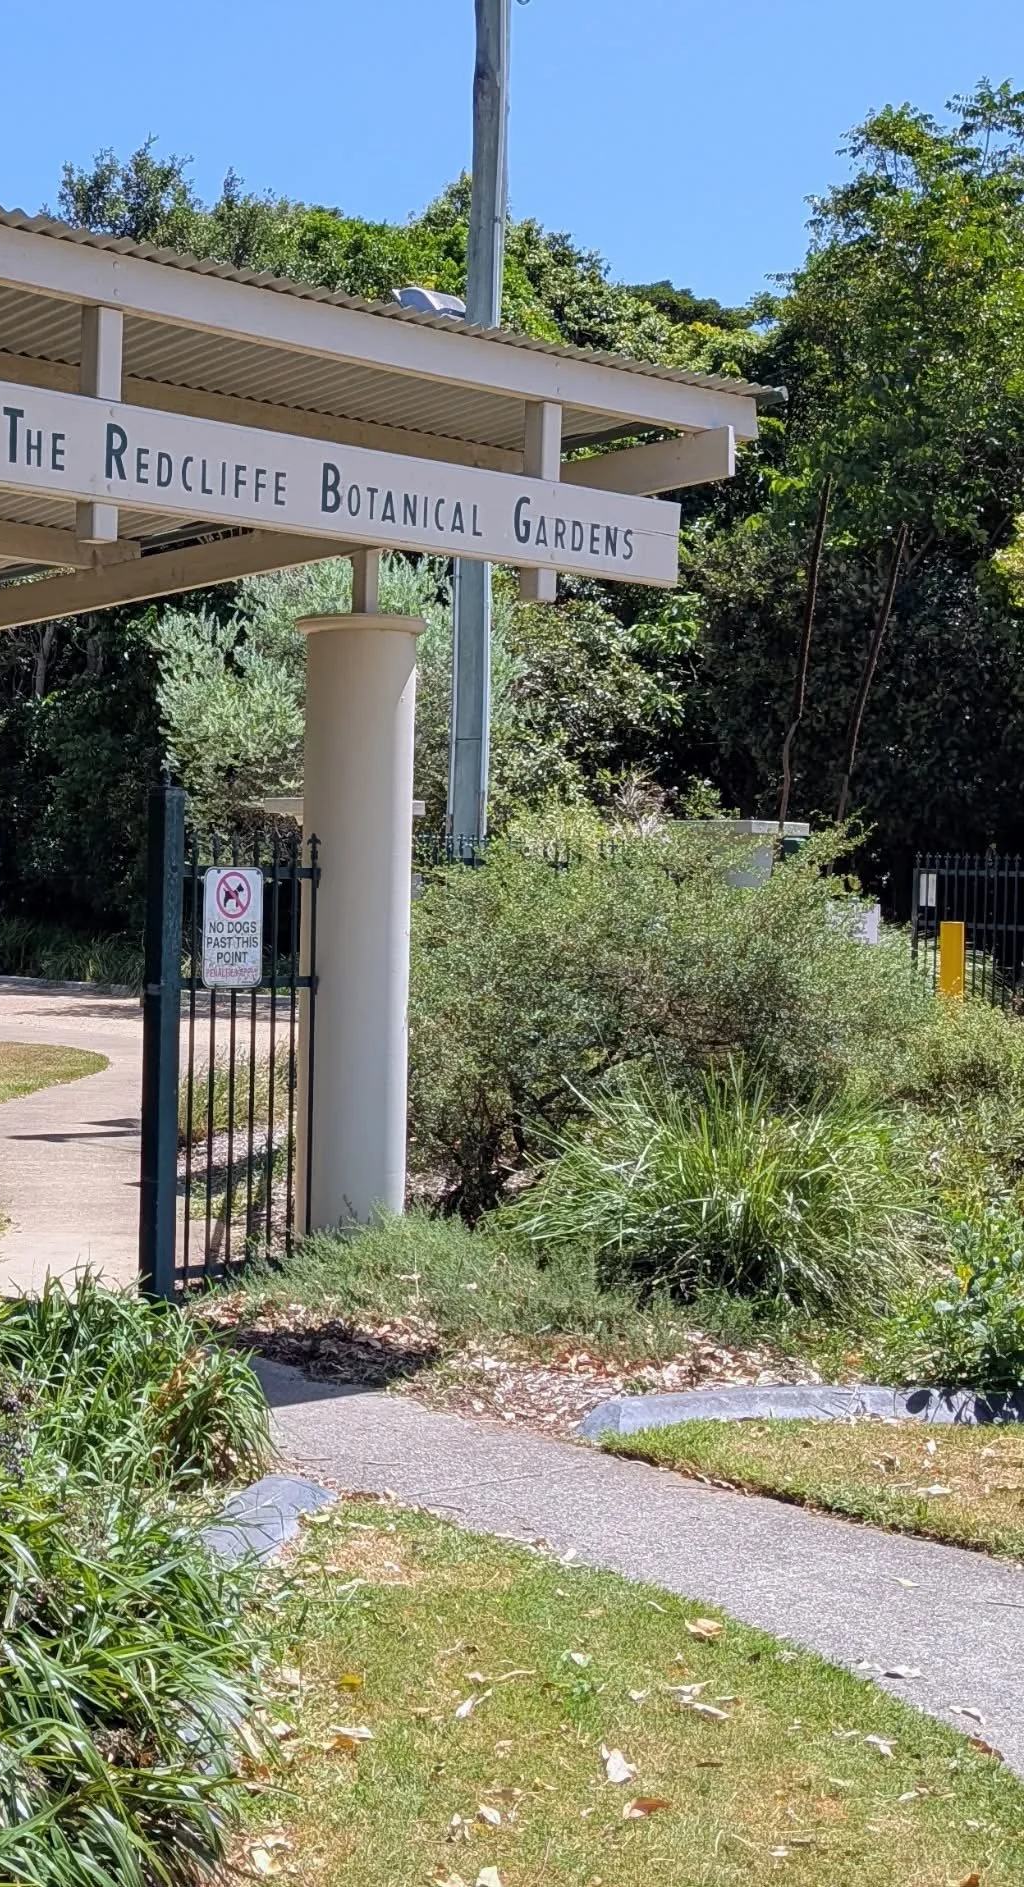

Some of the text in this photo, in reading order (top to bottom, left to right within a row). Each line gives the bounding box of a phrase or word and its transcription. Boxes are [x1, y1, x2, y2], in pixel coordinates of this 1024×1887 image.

[209, 921, 257, 934] NO DOGS
[206, 936, 259, 949] PAST THIS
[216, 951, 248, 964] POINT
